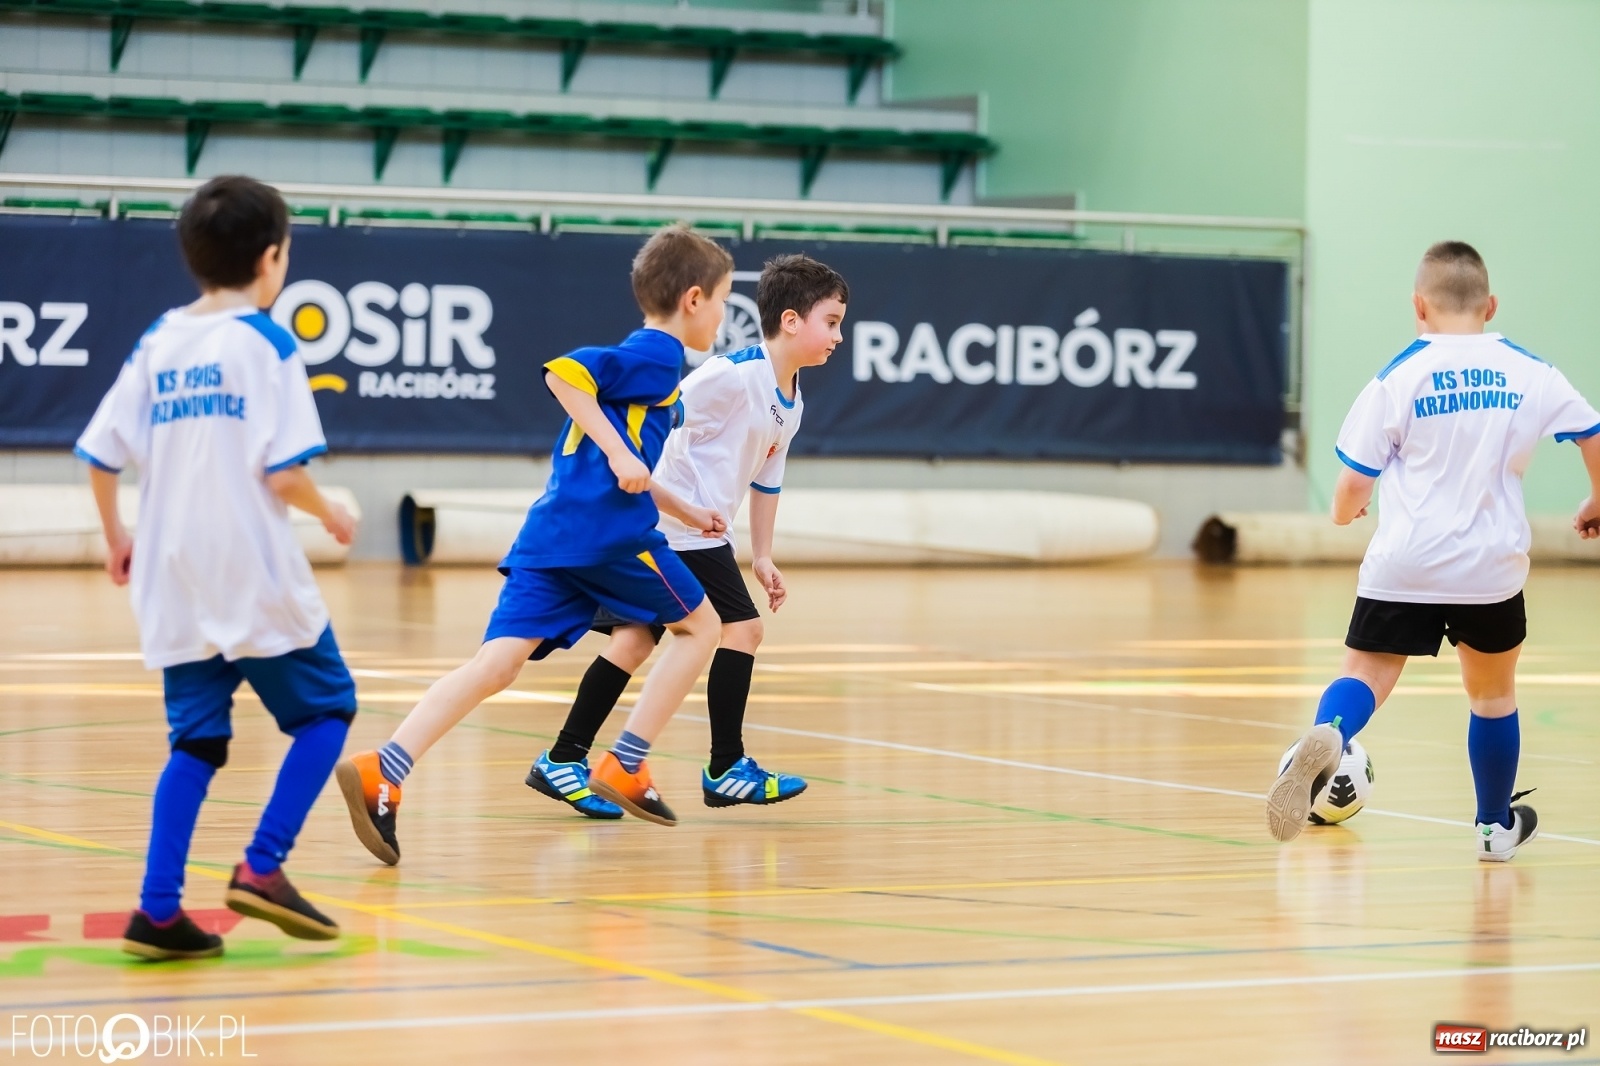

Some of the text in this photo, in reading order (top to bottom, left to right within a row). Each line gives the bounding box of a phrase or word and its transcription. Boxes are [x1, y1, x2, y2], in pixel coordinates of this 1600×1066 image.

[853, 307, 1198, 390] RACIBÓRZ
[358, 366, 496, 400] RACIBÓRZ
[1432, 368, 1507, 391] KS 1905
[1414, 390, 1523, 419] KRZANOWIC
[378, 783, 389, 817] FILA
